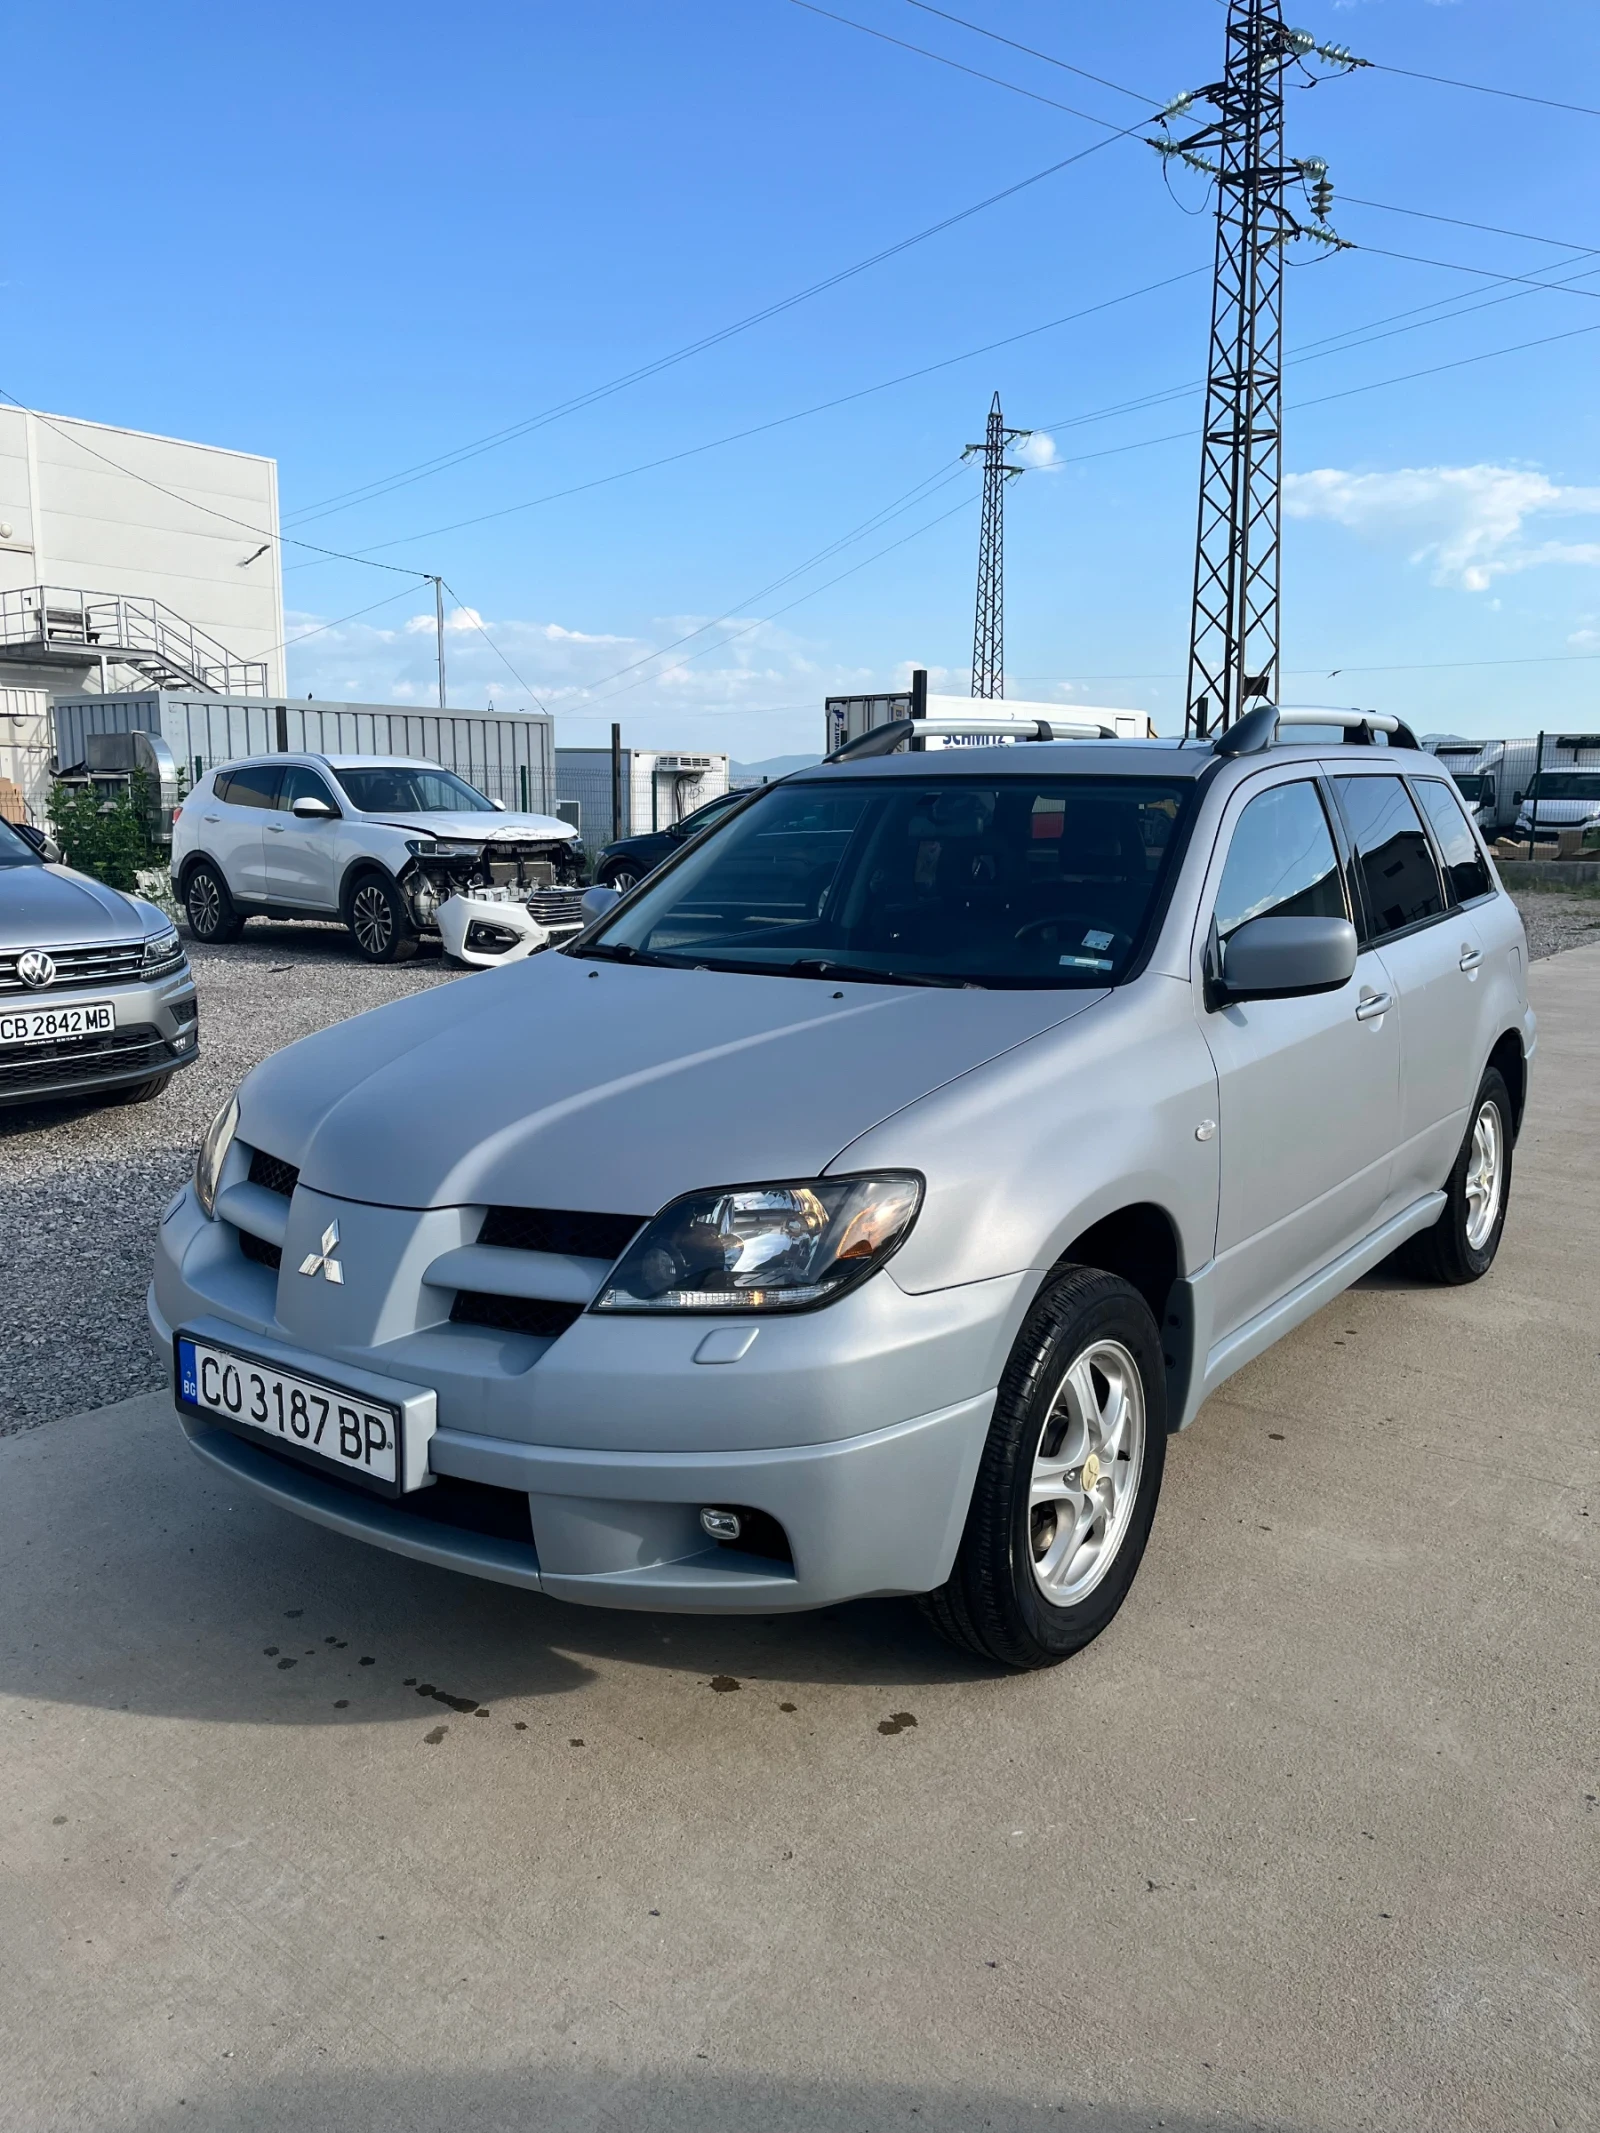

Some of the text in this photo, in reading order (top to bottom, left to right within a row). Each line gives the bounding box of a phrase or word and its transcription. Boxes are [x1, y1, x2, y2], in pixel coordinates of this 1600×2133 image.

[1, 1009, 110, 1039] CB 2842 MB
[183, 1379, 197, 1396] BG
[201, 1356, 387, 1466] CO 3187 BP
